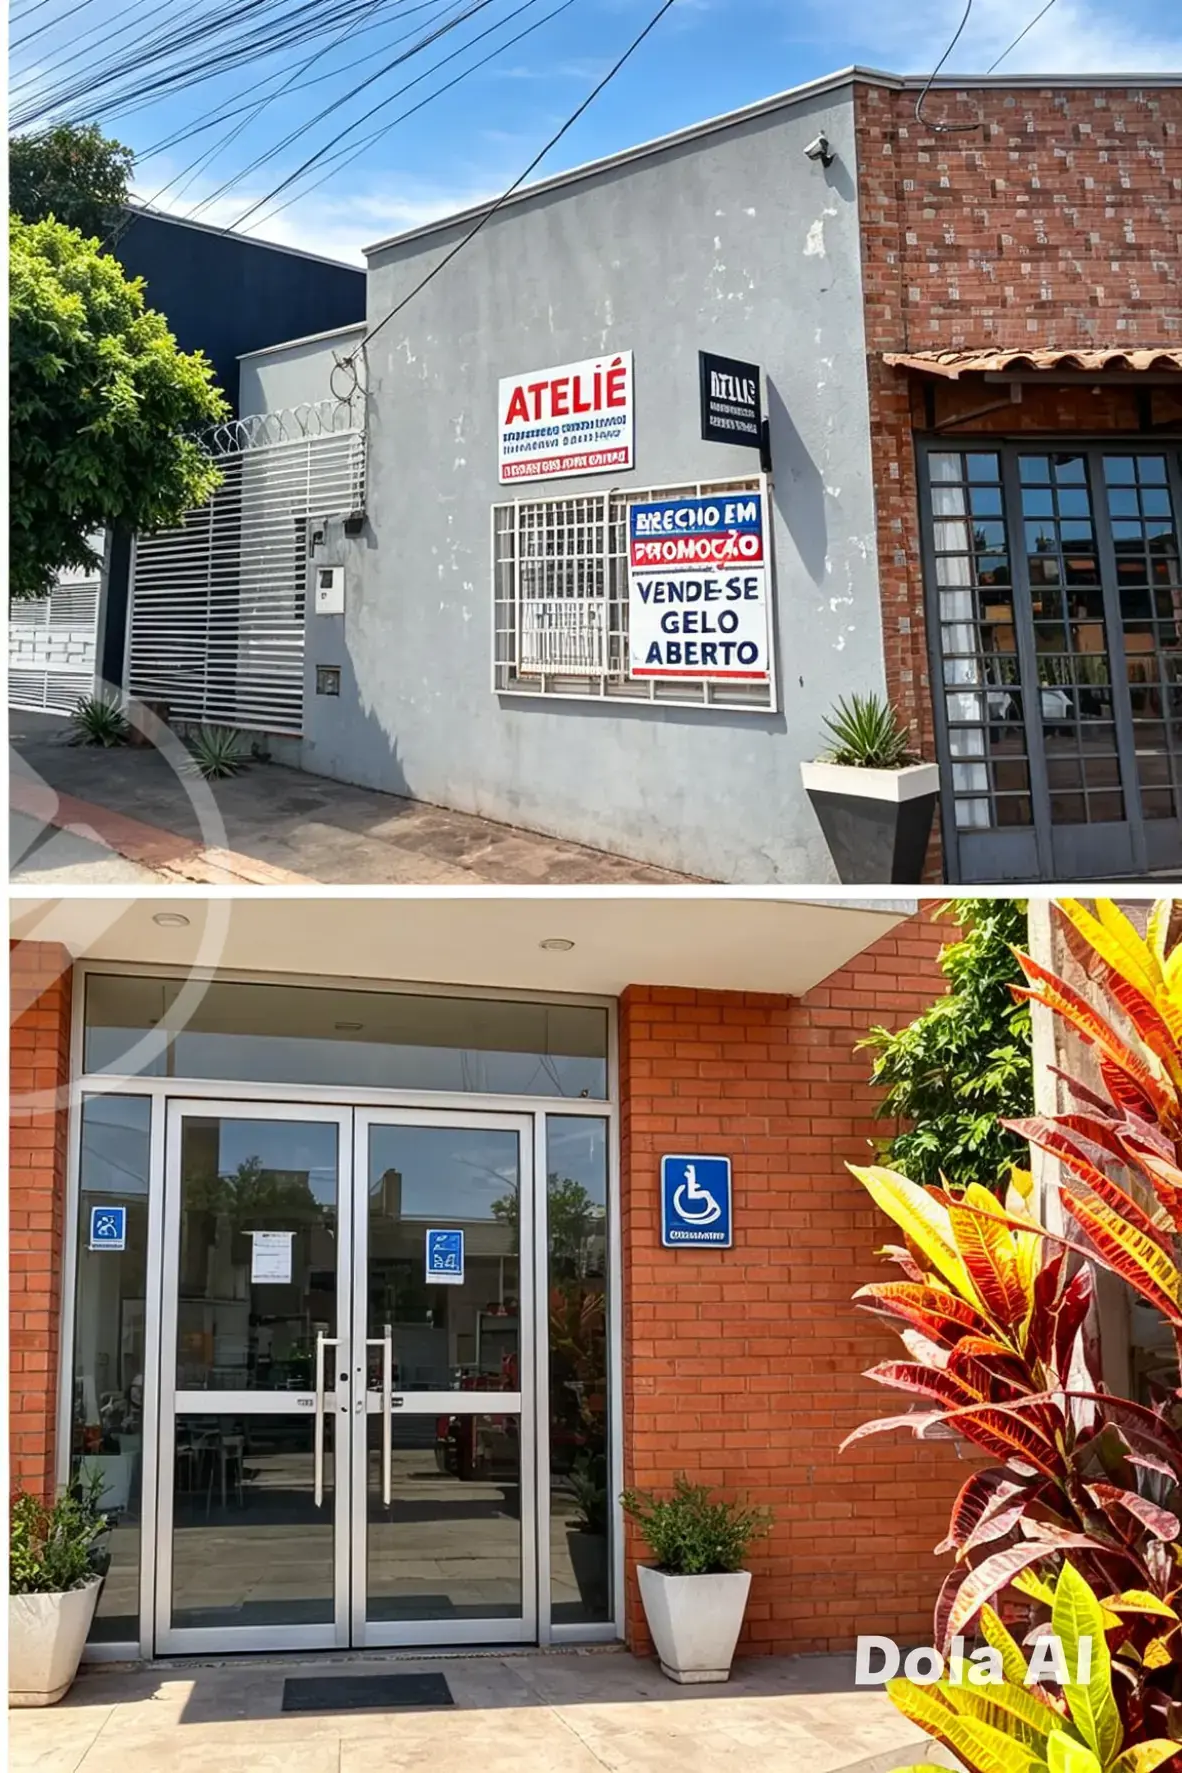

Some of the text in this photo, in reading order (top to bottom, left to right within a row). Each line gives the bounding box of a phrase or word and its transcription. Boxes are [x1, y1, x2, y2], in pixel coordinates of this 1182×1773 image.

[504, 356, 627, 425] ATELIÉ
[724, 501, 757, 525] EM
[660, 609, 739, 634] GELO
[645, 640, 759, 666] ABERTO
